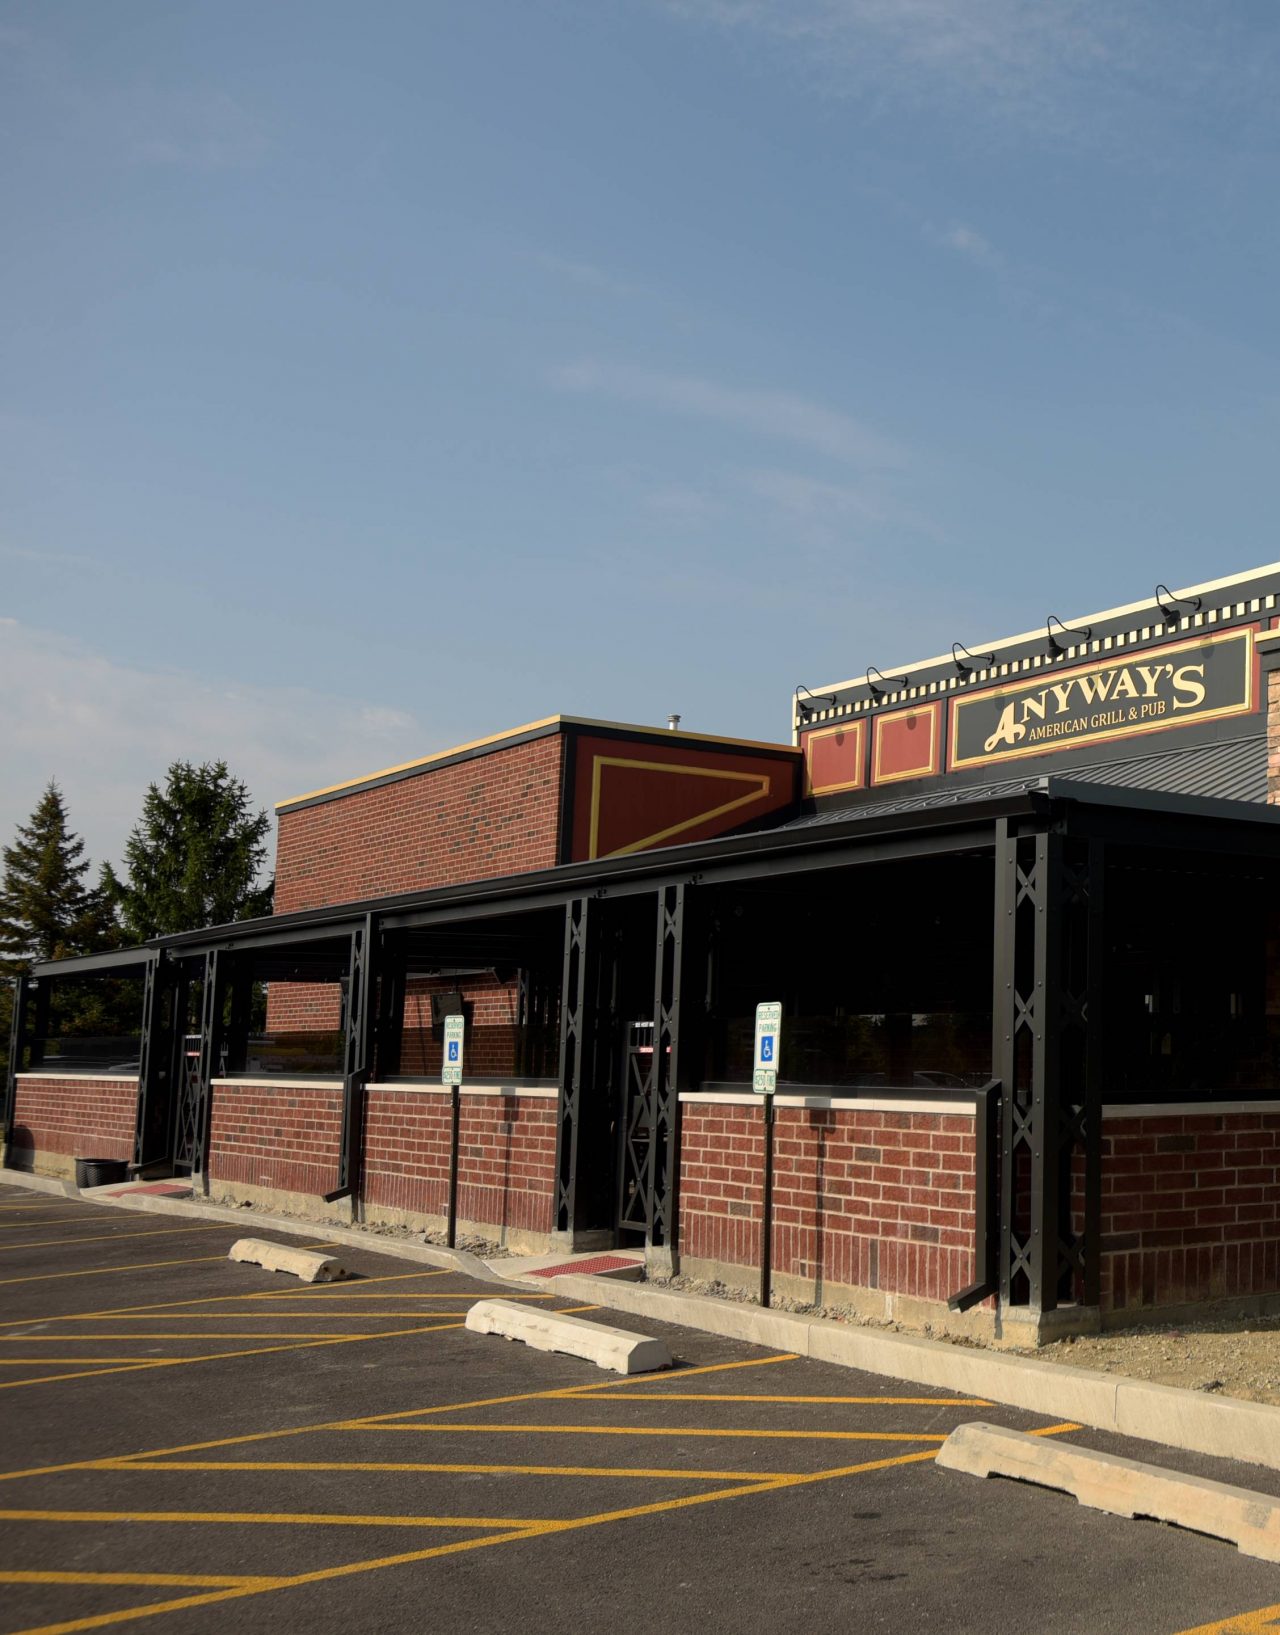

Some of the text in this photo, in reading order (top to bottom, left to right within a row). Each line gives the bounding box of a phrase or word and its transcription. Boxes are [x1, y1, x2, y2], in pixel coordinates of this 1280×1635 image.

[984, 664, 1206, 752] ANYWAY'S
[1029, 700, 1166, 741] AMERICAN GRILL & PUB
